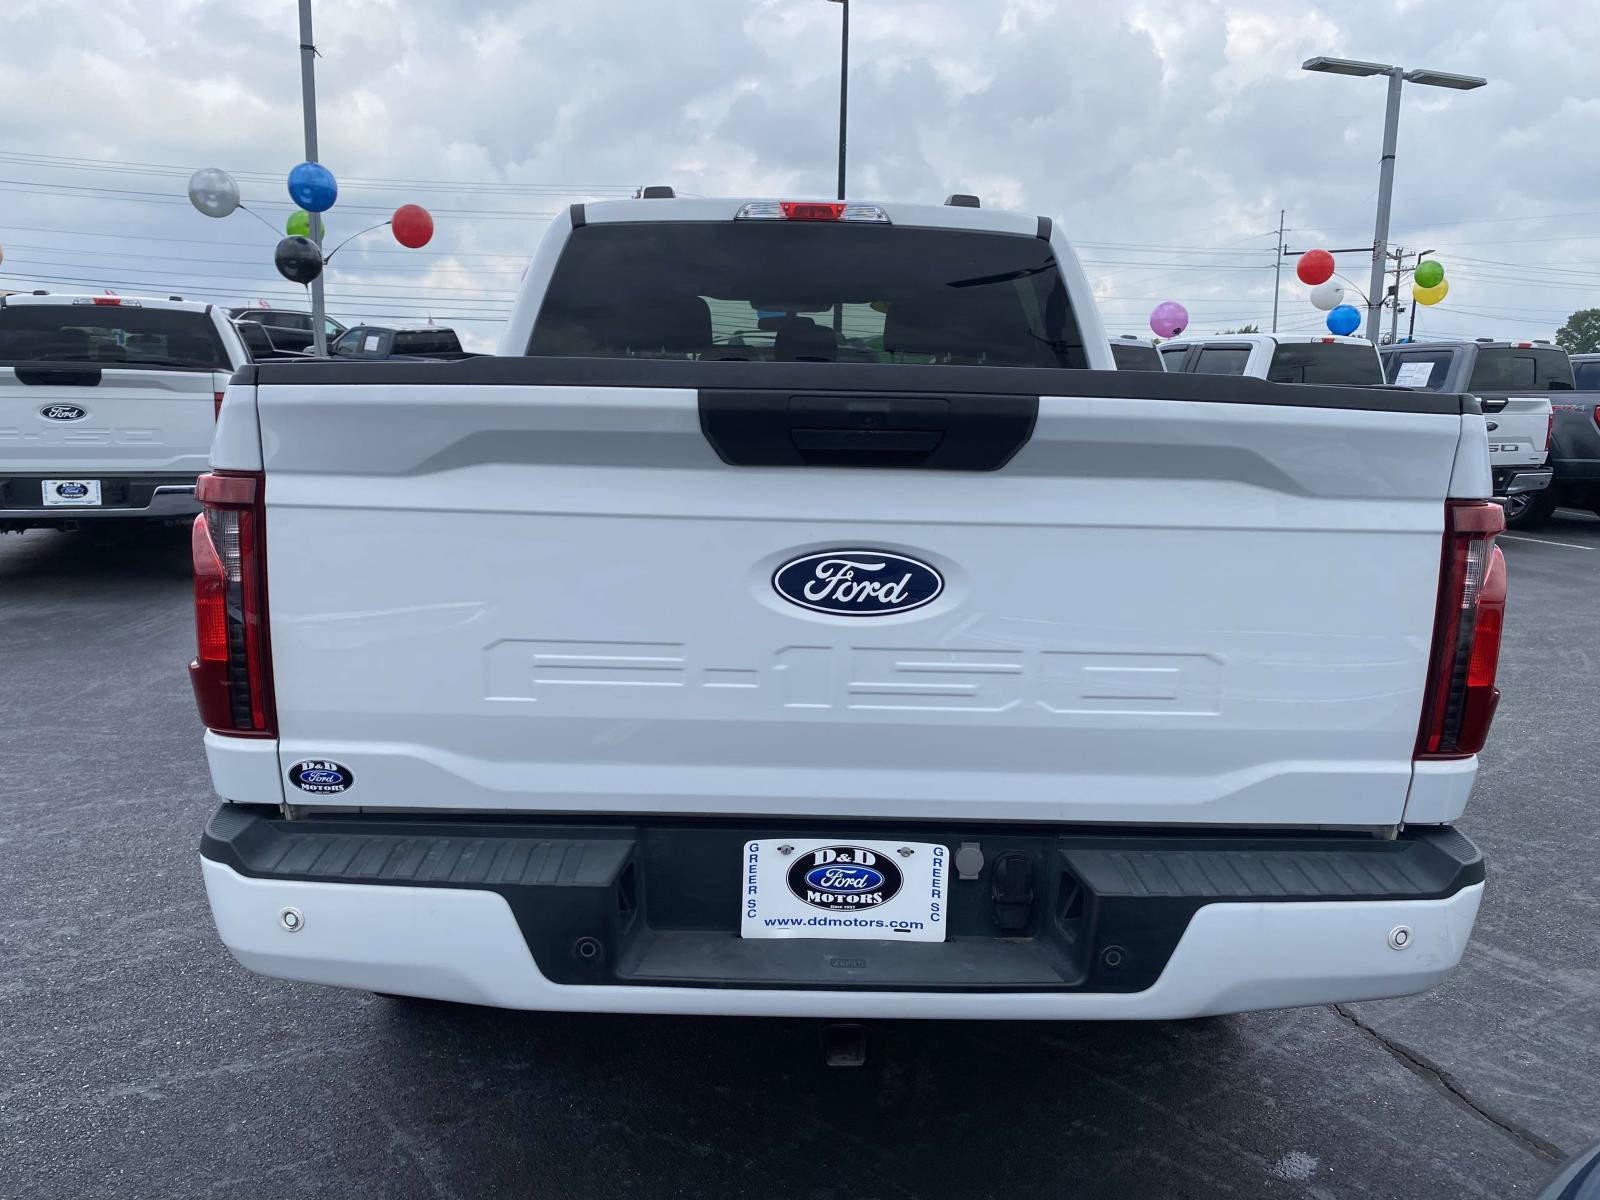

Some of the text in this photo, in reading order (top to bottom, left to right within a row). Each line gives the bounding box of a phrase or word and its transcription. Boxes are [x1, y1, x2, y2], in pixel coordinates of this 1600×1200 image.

[49, 406, 78, 418] Ford
[804, 559, 912, 603] Ford
[483, 638, 1225, 717] F-150
[302, 762, 338, 771] D&D
[308, 772, 334, 783] Ford
[301, 783, 345, 791] MOTORS
[813, 848, 876, 866] D&D
[747, 843, 759, 918] GREER SC
[820, 868, 869, 888] Ford
[930, 847, 944, 922] GREER SC
[806, 890, 883, 904] MOTORS
[764, 917, 924, 930] www.ddmotors.com
